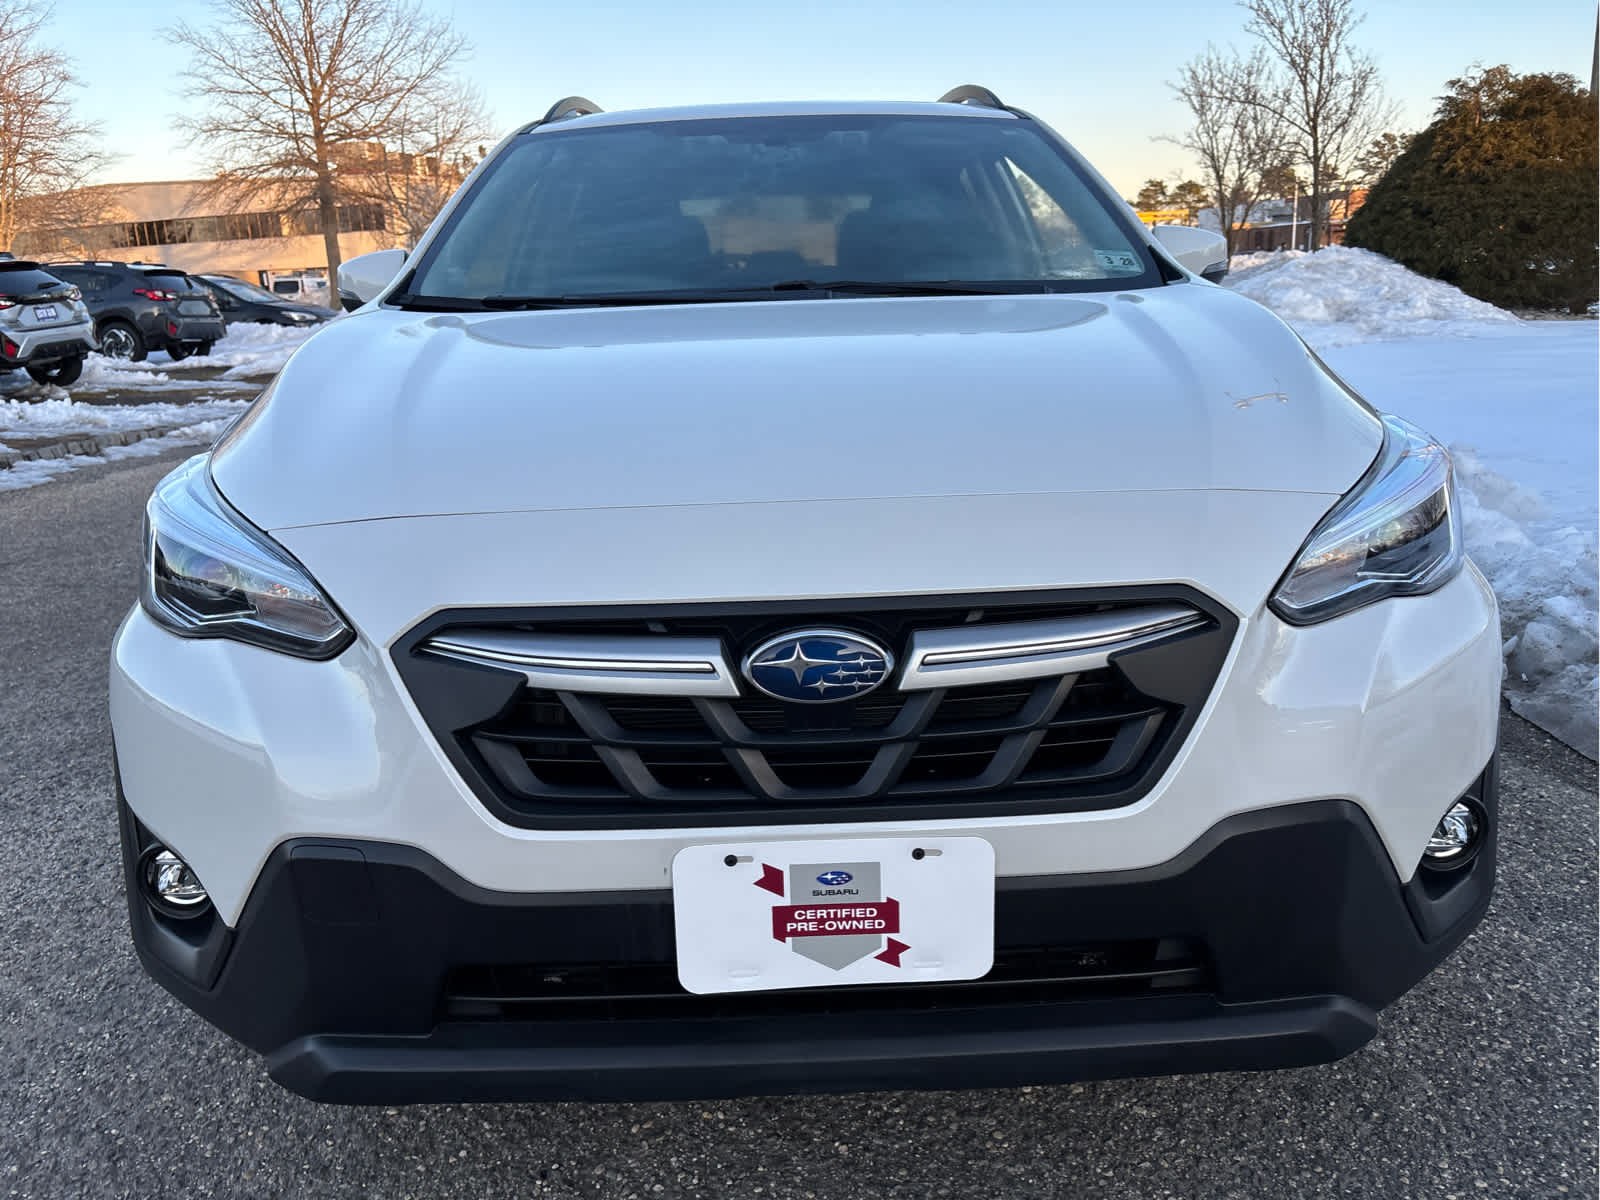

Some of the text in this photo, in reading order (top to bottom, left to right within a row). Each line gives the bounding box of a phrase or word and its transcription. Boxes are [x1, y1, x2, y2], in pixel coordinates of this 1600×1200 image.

[812, 888, 859, 897] SUBARU
[794, 907, 878, 920] CERTIFIED
[786, 919, 886, 933] PRE-OWNED
